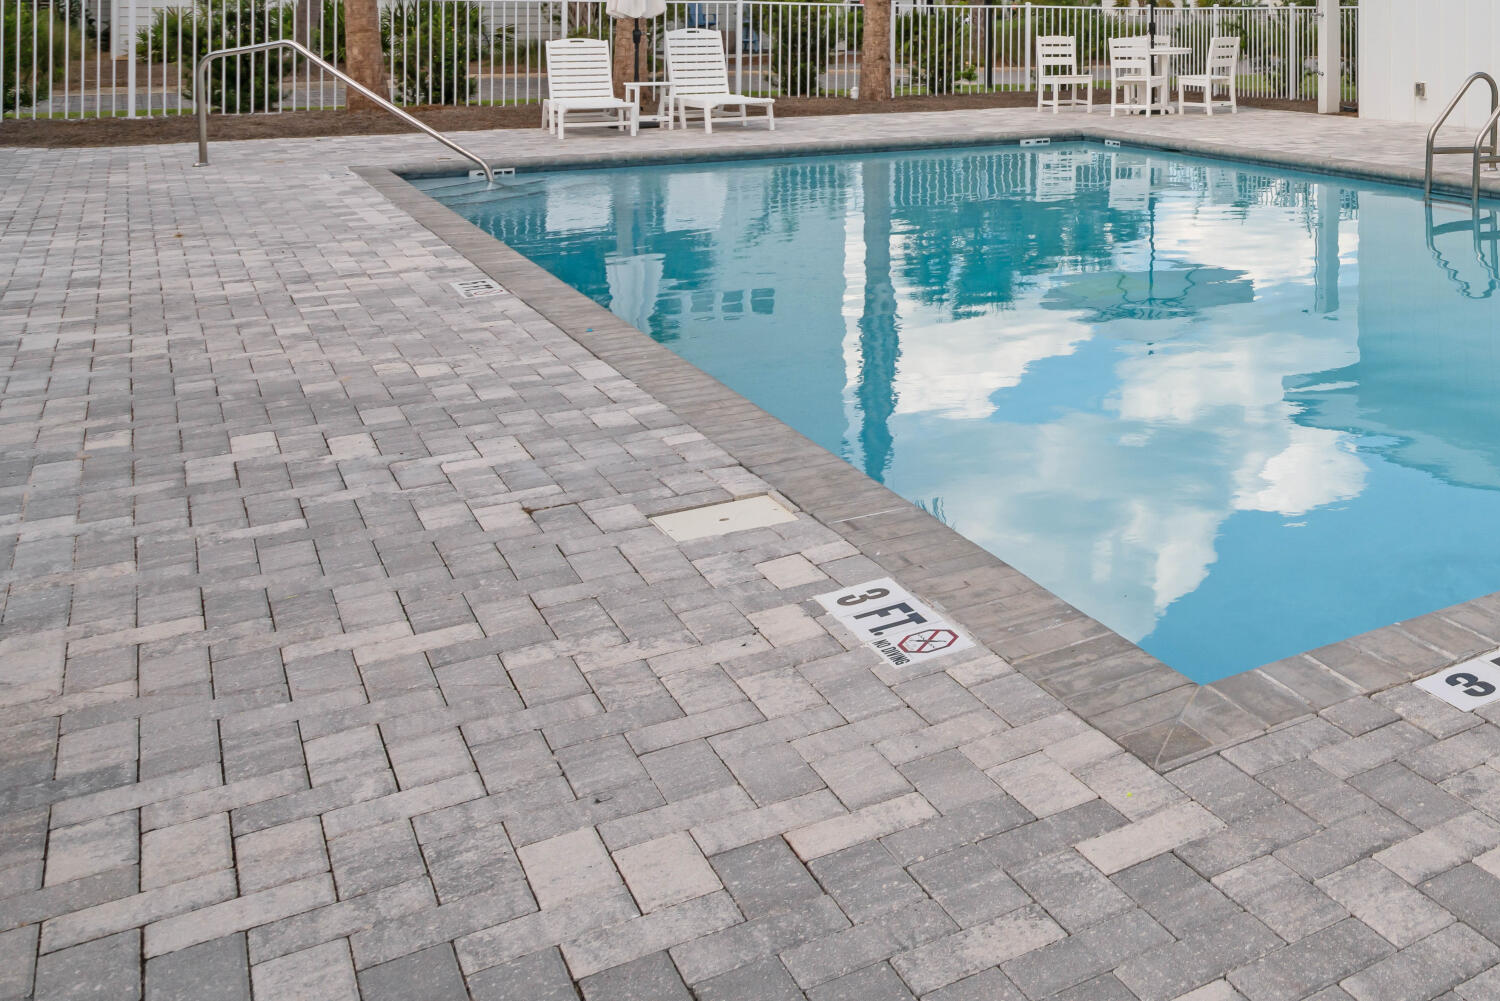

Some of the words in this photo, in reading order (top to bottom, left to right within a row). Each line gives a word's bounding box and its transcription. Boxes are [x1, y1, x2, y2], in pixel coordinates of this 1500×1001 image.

[836, 587, 890, 606] 3
[852, 601, 928, 636] FT.
[872, 639, 891, 648] NO
[880, 645, 911, 666] DIVING
[1444, 672, 1497, 697] 3
